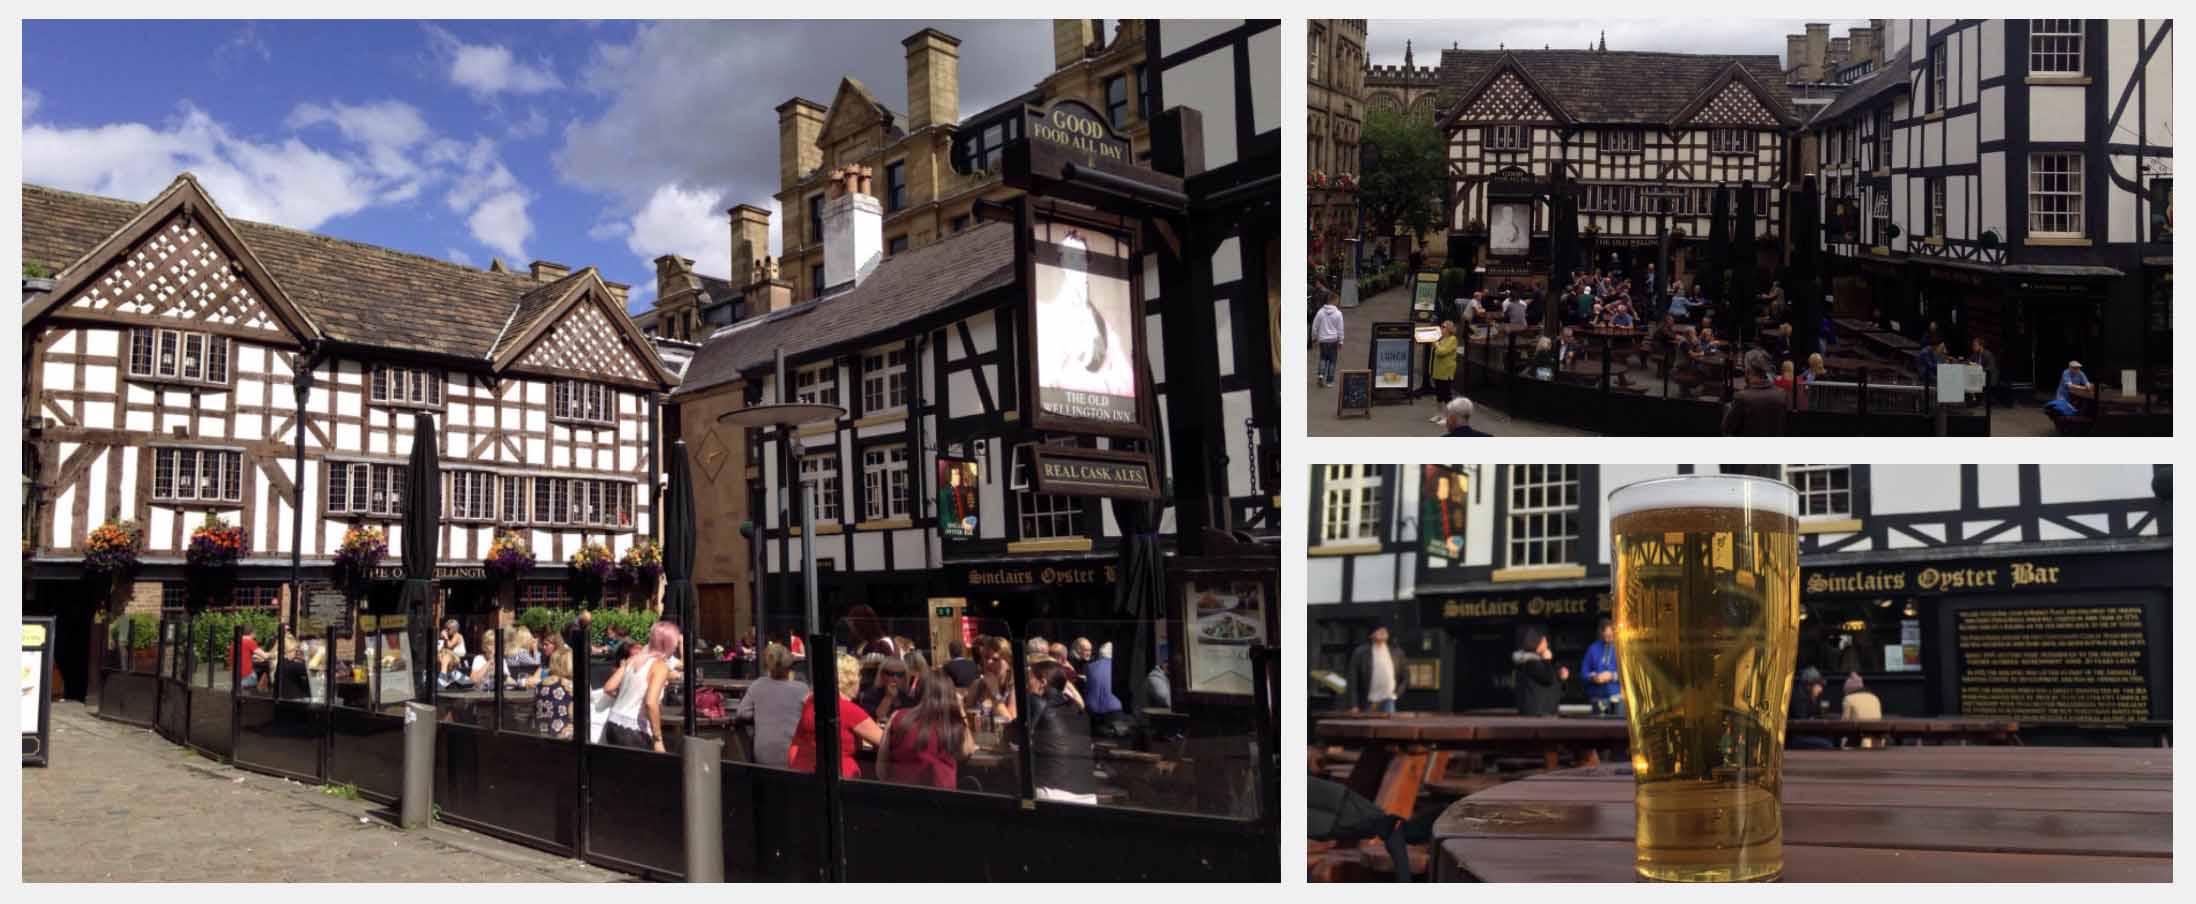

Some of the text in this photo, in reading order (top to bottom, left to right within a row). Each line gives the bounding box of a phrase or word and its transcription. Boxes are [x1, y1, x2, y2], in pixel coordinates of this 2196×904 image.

[1053, 110, 1103, 139] GOOD
[1034, 122, 1121, 160] FOOD ALL DAY
[1064, 391, 1110, 407] THE OLD
[1043, 401, 1132, 423] WELLINGTON INN
[1044, 463, 1144, 482] REAL CASK ALES
[968, 568, 1033, 585] Sinclairs
[1040, 566, 1095, 586] Oyster
[1806, 561, 2061, 593] Sinclairs Oyster Bar
[1443, 598, 1520, 617] Sinclairs
[1528, 596, 1587, 617] Oyster
